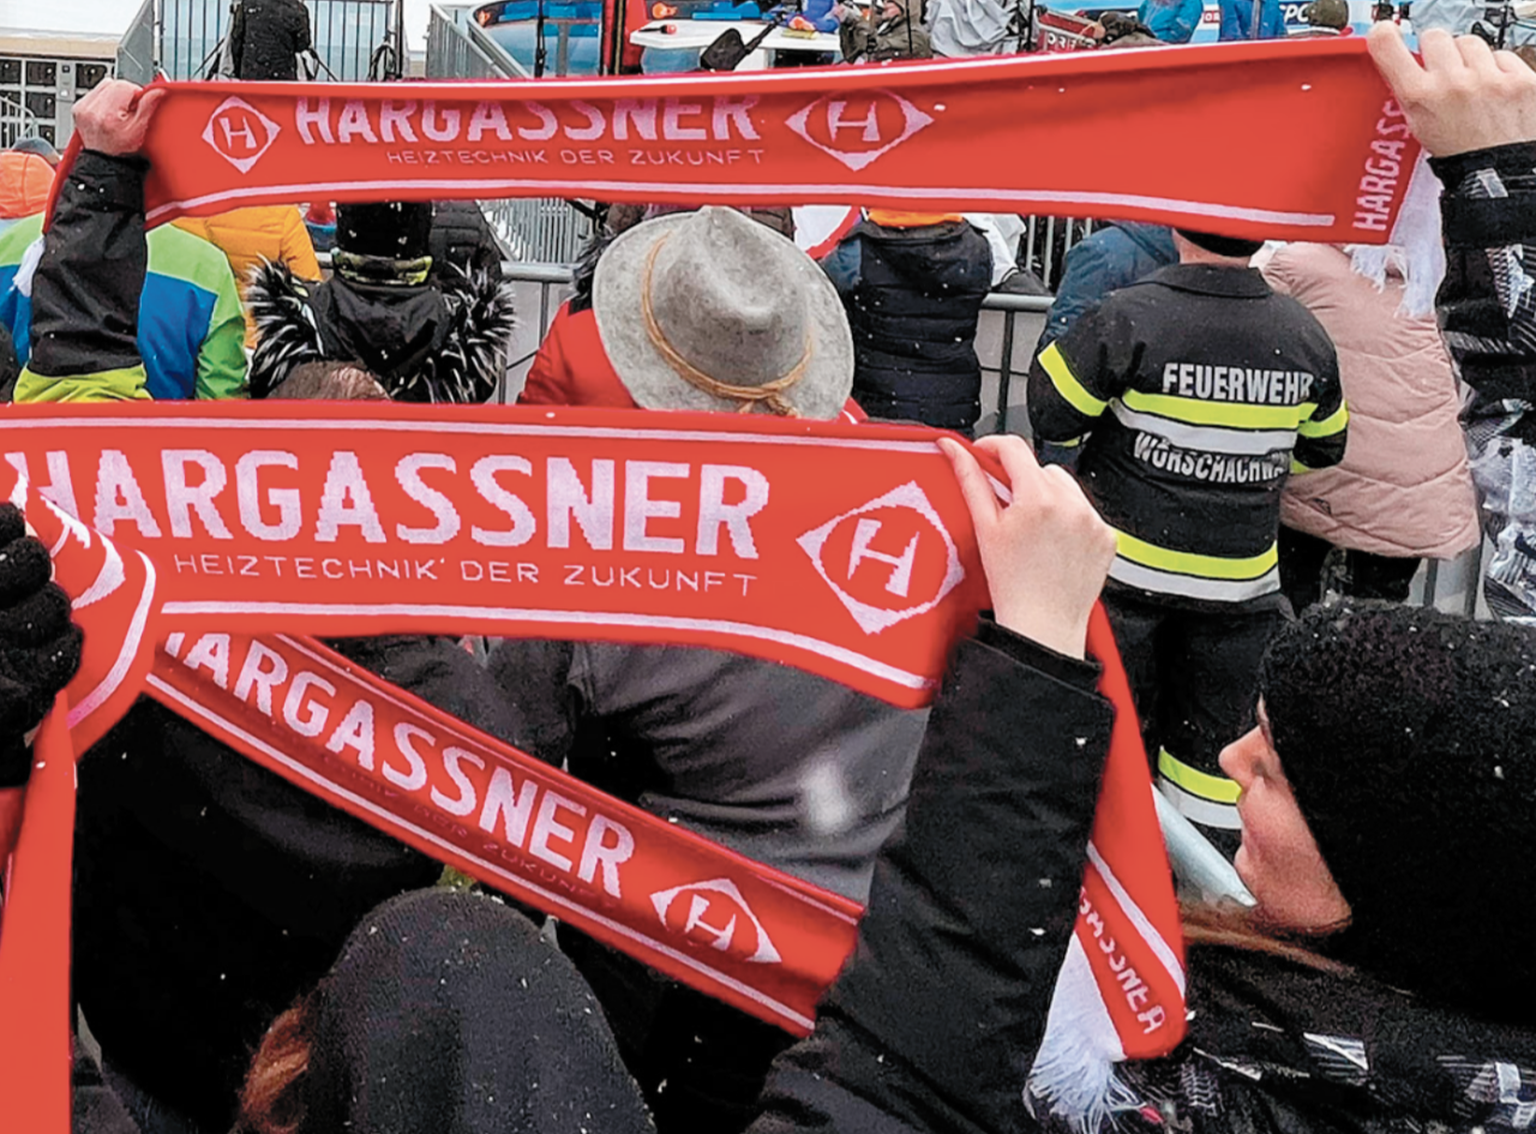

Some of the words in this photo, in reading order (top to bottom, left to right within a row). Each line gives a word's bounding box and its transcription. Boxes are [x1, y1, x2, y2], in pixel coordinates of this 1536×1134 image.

[295, 95, 761, 144] HARGASSNER
[387, 148, 550, 166] HEIZTECHNIK
[561, 148, 615, 166] DER
[630, 148, 764, 166] ZUKUNFT
[1162, 362, 1314, 405] FEUERWEHR
[175, 553, 437, 583] HEIZTECHNIK
[460, 557, 540, 586] DER
[562, 564, 758, 596] ZUKUNFT
